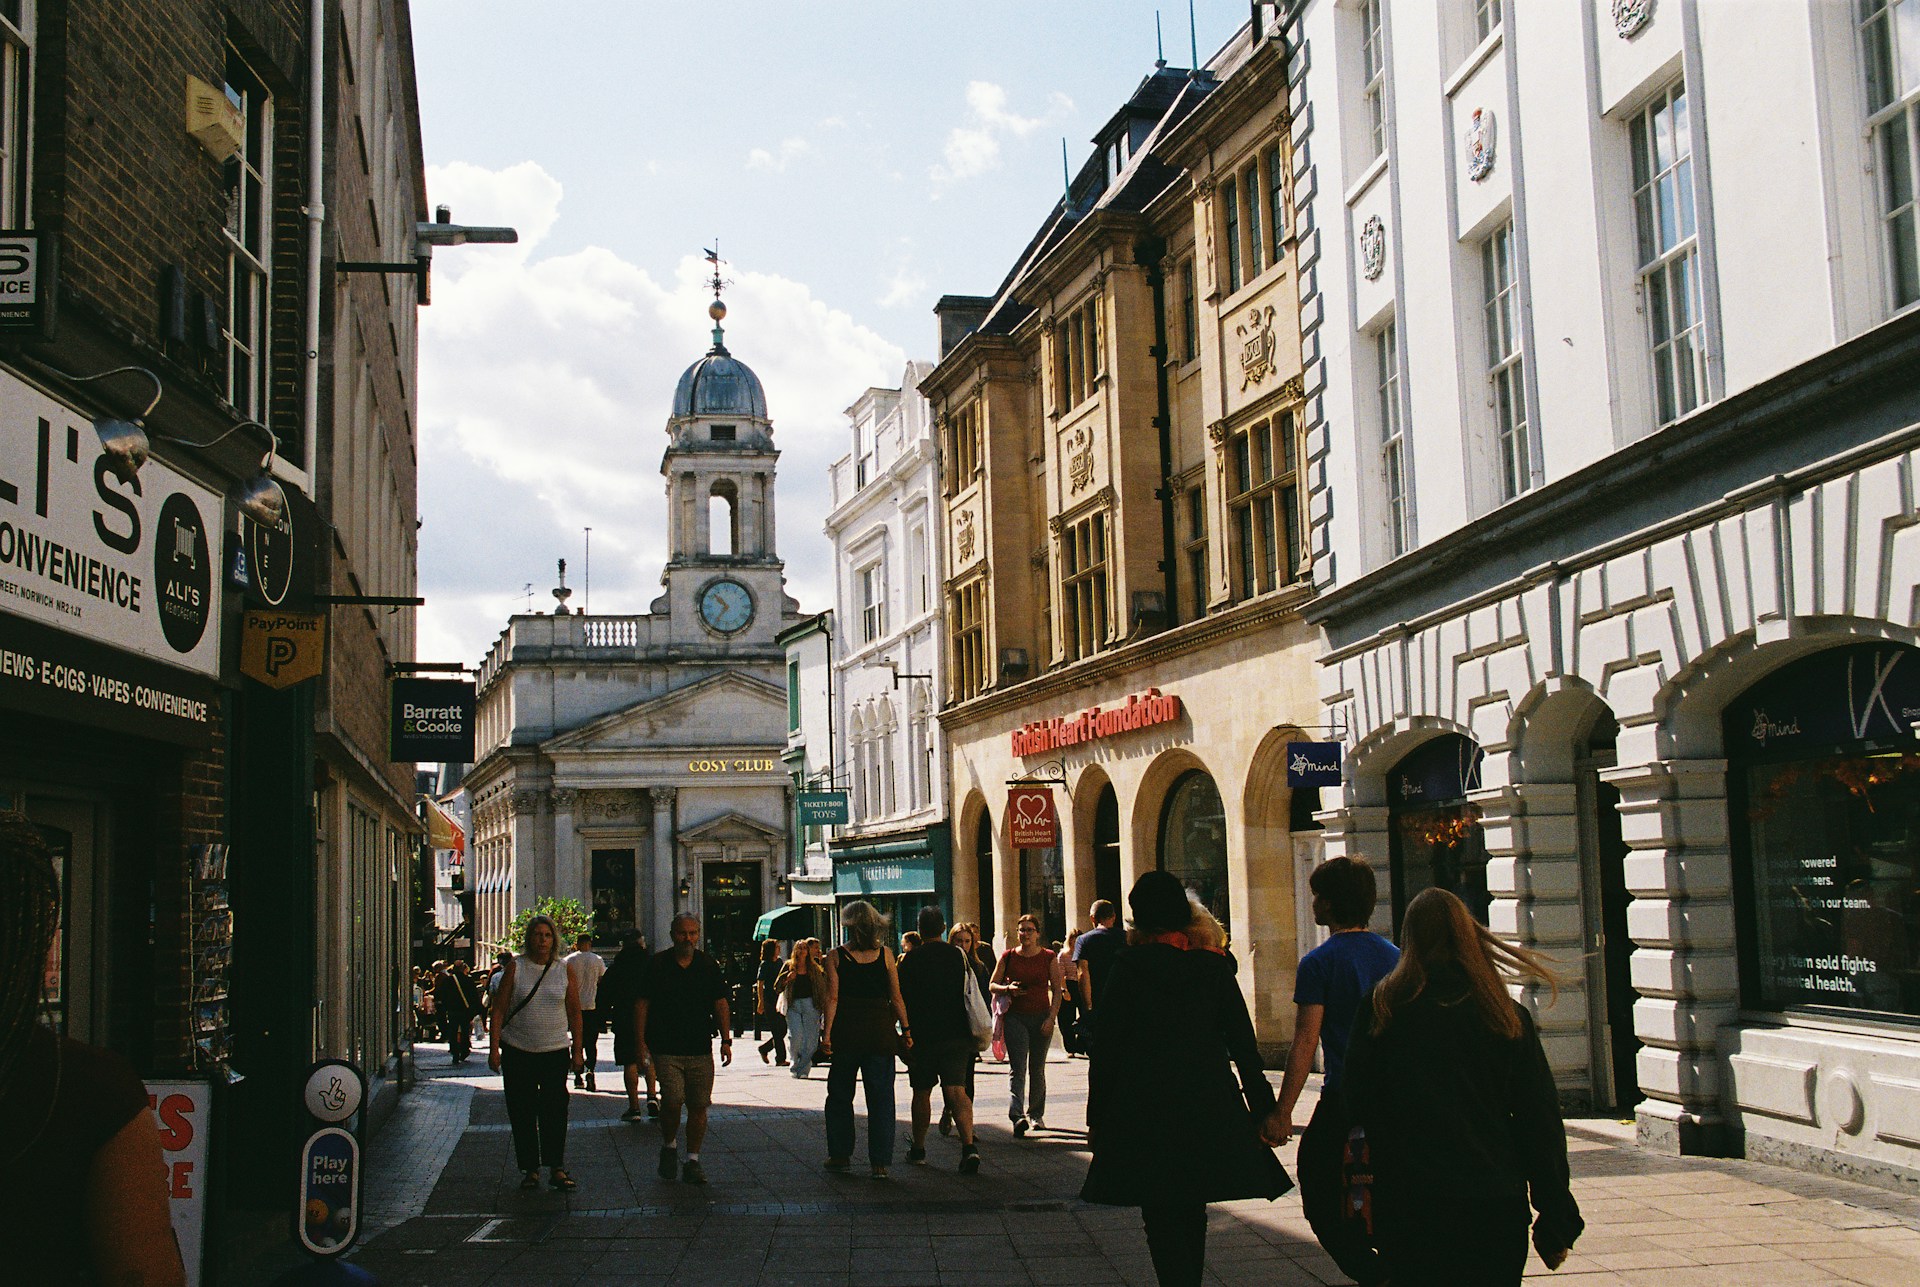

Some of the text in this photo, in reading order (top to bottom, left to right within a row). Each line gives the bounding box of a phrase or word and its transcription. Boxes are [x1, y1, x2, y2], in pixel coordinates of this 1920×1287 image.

[20, 586, 54, 608] NORWICH
[166, 579, 200, 607] ALI'S
[250, 617, 318, 632] PayPoint
[42, 661, 86, 693] E-CIGS
[92, 674, 130, 704] VAPES
[135, 685, 207, 722] CONVENIENCE
[403, 704, 463, 720] Barratt
[1011, 689, 1177, 758] British Heart Foundation
[1766, 715, 1801, 737] mind
[689, 759, 774, 773] COSY CLUB
[1307, 760, 1340, 772] mind
[812, 810, 837, 819] TOYS
[1826, 898, 1842, 909] our
[1842, 897, 1871, 909] team.
[1815, 955, 1839, 970] sold
[1840, 955, 1877, 976] fights
[1816, 974, 1857, 992] health.
[313, 1155, 348, 1173] Play
[312, 1171, 348, 1185] here
